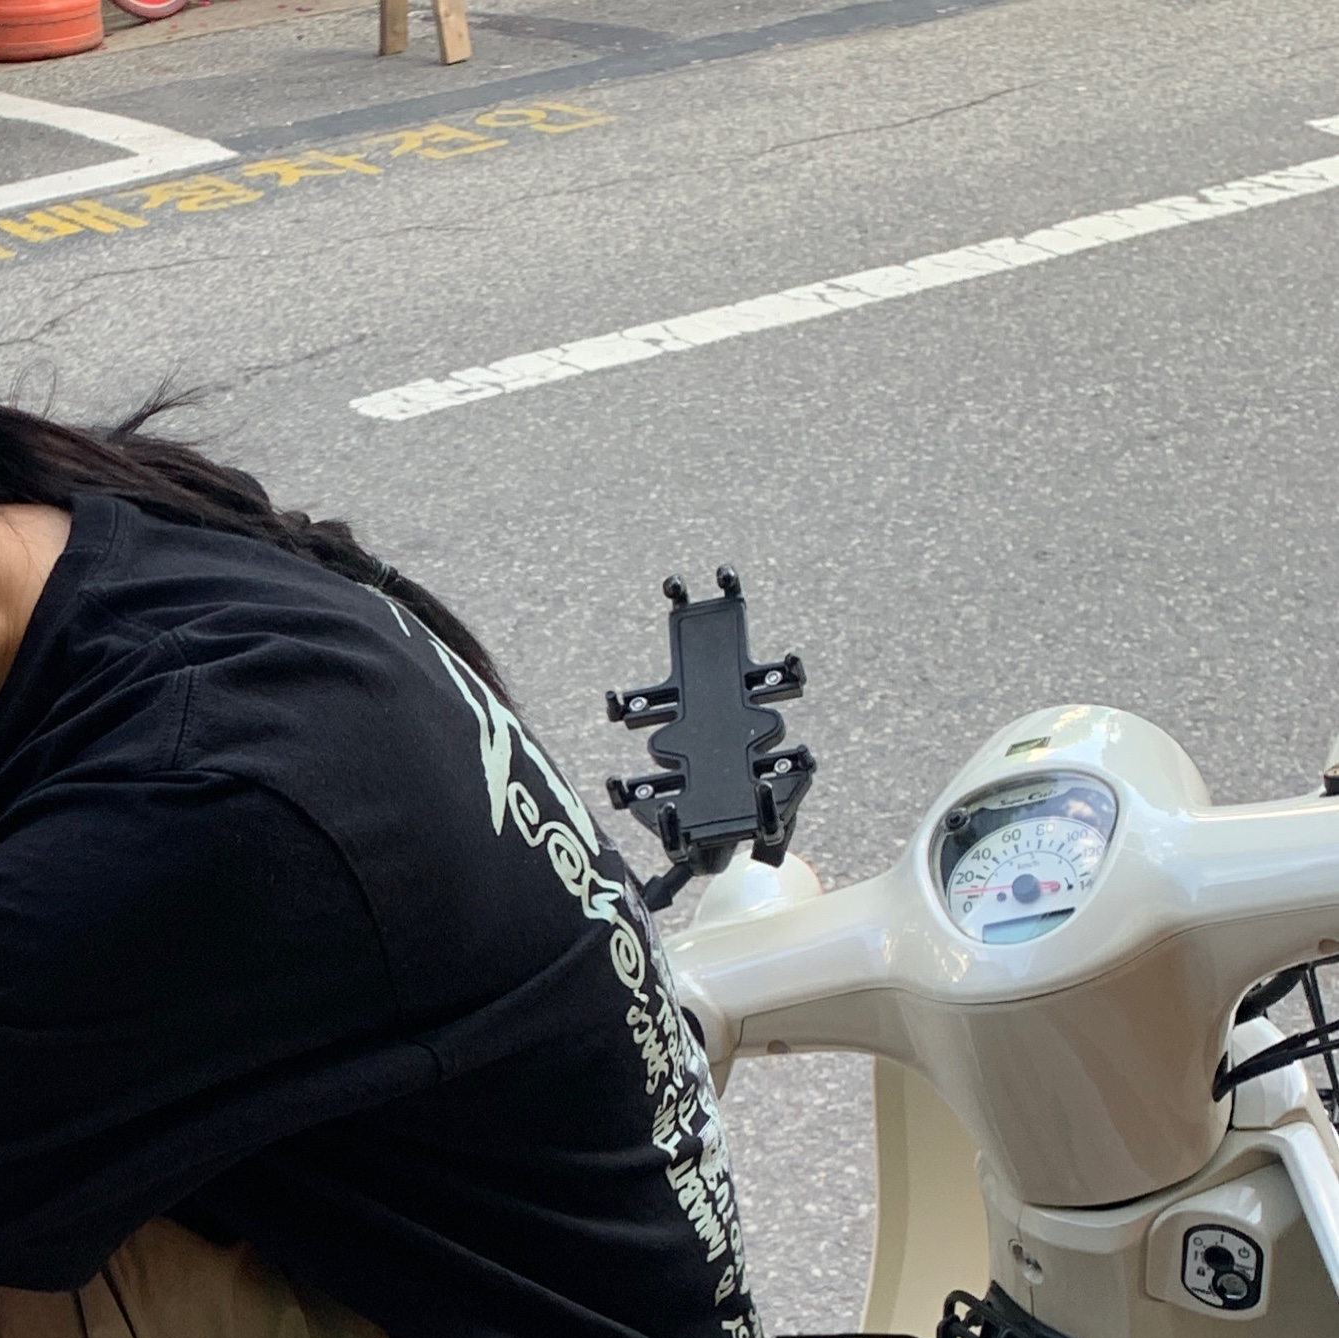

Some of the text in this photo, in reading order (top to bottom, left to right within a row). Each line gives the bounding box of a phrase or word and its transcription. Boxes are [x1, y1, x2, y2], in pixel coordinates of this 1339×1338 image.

[1001, 828, 1022, 843] 60
[1036, 823, 1056, 836] 80
[1066, 828, 1089, 842] 100
[971, 848, 991, 861] 40
[955, 870, 974, 885] 20
[963, 901, 973, 914] 0
[652, 1083, 683, 1160] THIS
